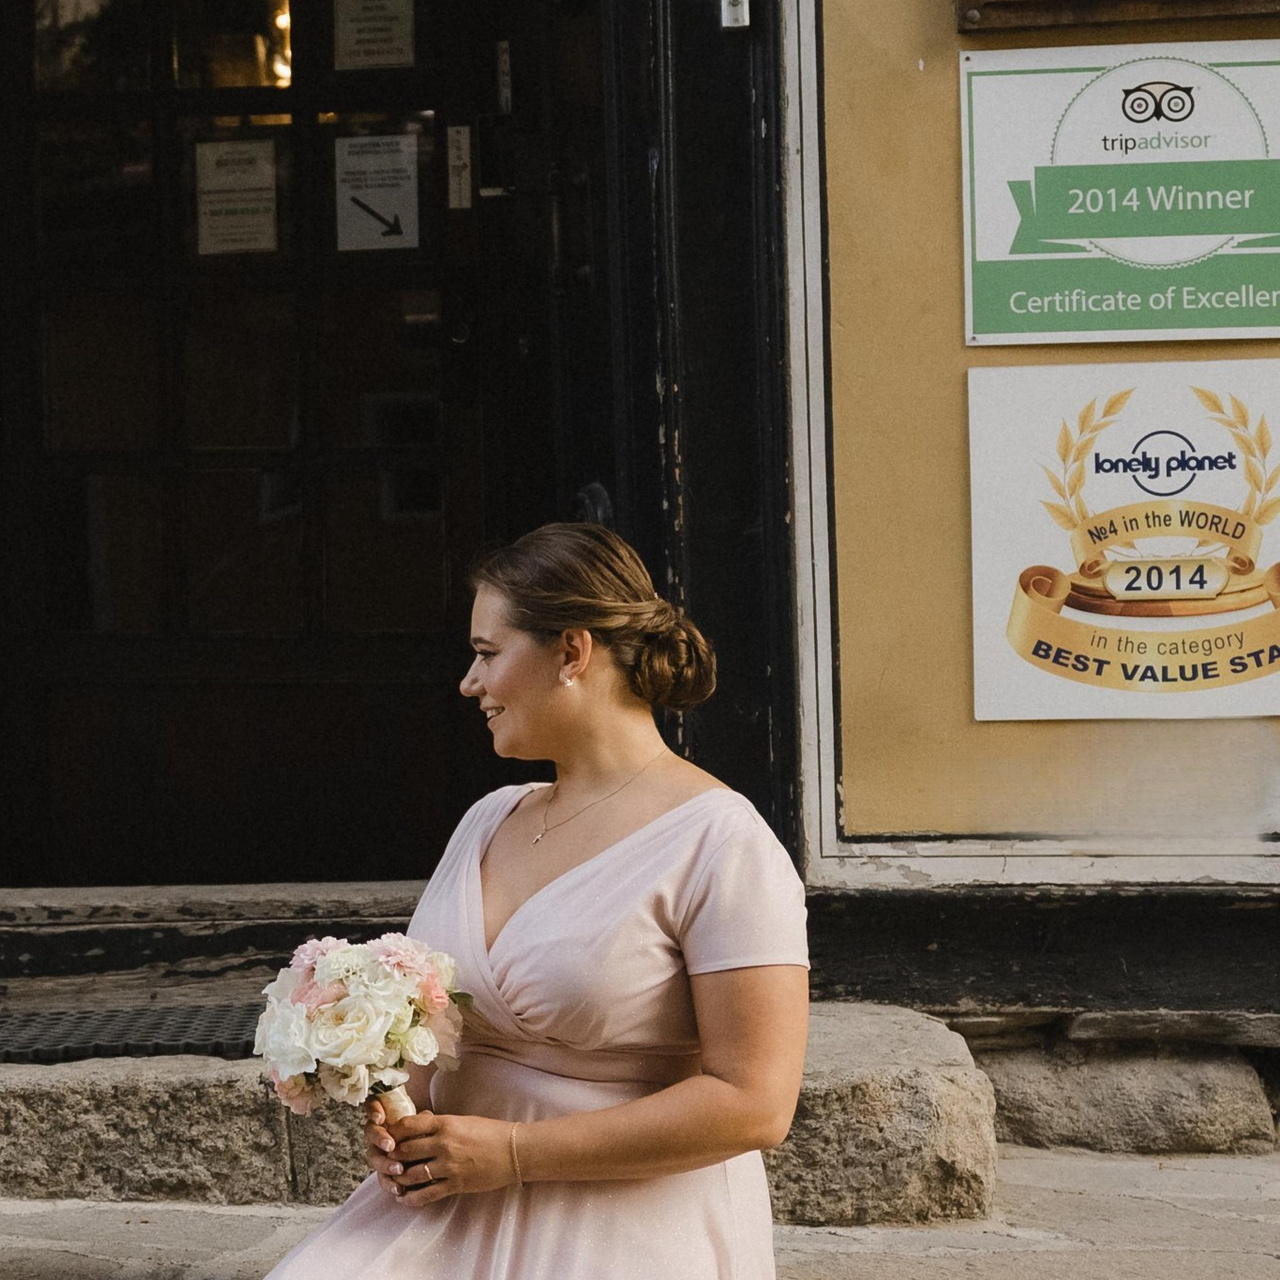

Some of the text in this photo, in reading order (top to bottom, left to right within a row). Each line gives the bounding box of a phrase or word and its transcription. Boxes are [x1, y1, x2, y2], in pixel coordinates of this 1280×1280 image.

[1102, 132, 1212, 155] tripadvisor
[1068, 185, 1255, 214] 2014 Winner
[1009, 288, 1142, 314] Certificate
[1149, 286, 1176, 310] of
[1094, 450, 1237, 479] lonely planet
[1122, 516, 1140, 532] in
[1144, 511, 1172, 529] the
[1179, 510, 1247, 540] WORLD
[1124, 564, 1208, 592] 2014
[1090, 630, 1245, 657] in the category
[1031, 639, 1111, 676] BEST
[1121, 661, 1220, 682] VALUE
